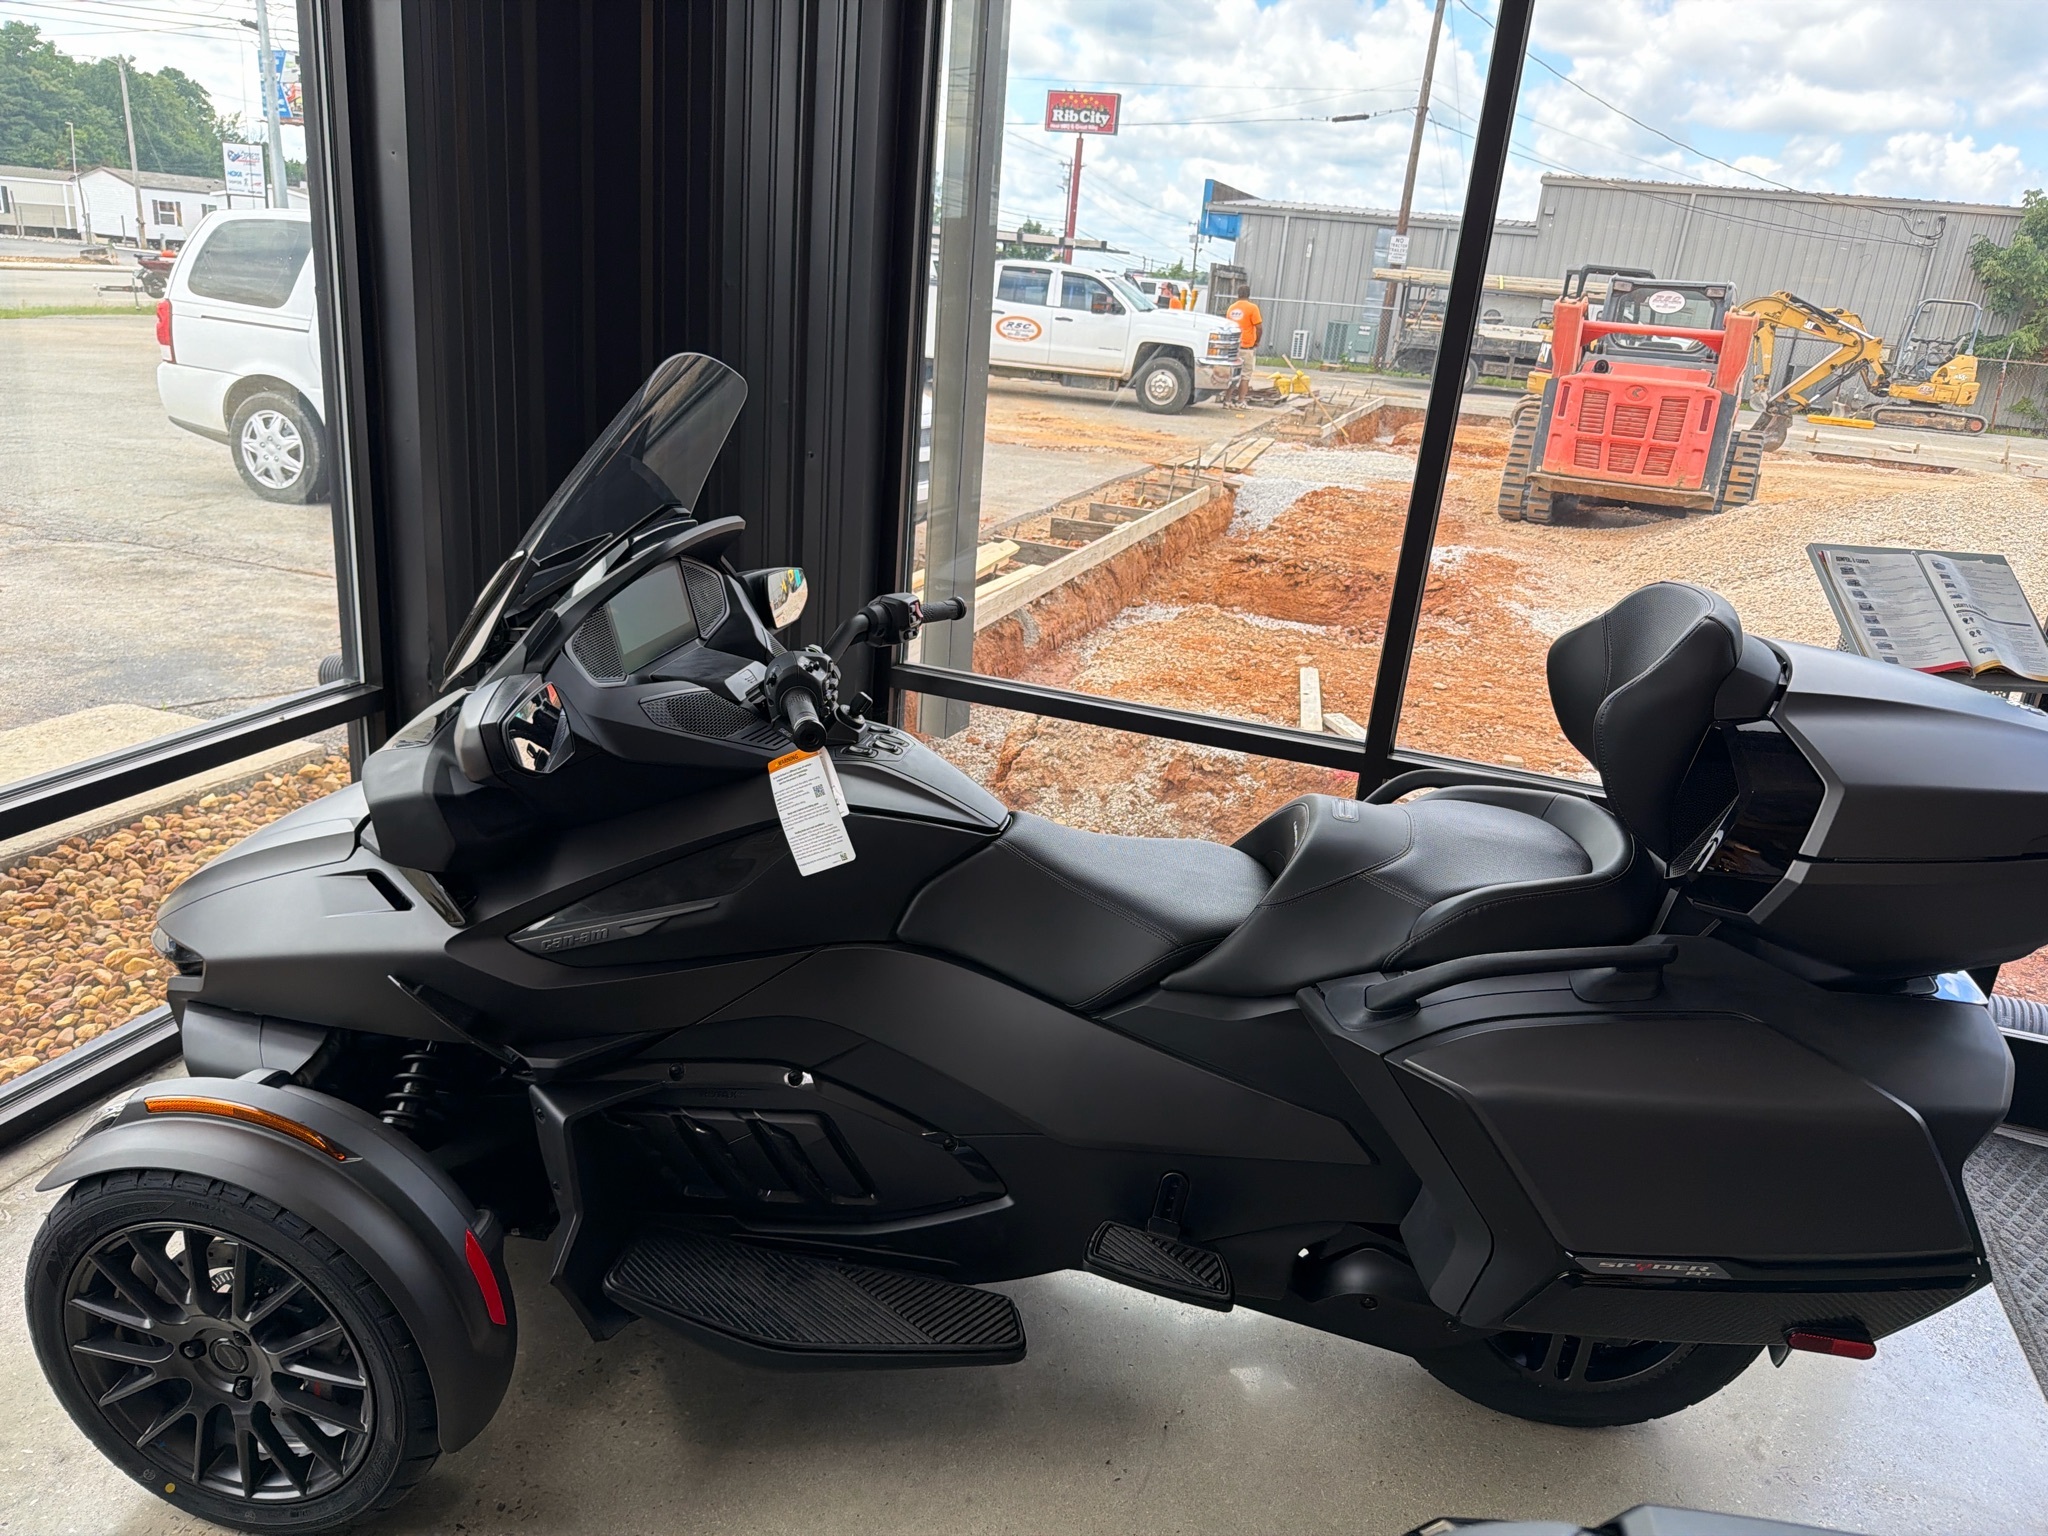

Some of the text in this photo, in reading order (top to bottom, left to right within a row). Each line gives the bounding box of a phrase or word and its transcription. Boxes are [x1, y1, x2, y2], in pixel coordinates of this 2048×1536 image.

[1006, 321, 1032, 330] RSC
[778, 753, 799, 766] WARNING
[541, 928, 609, 950] can-am
[1598, 1262, 1709, 1272] SPYDER
